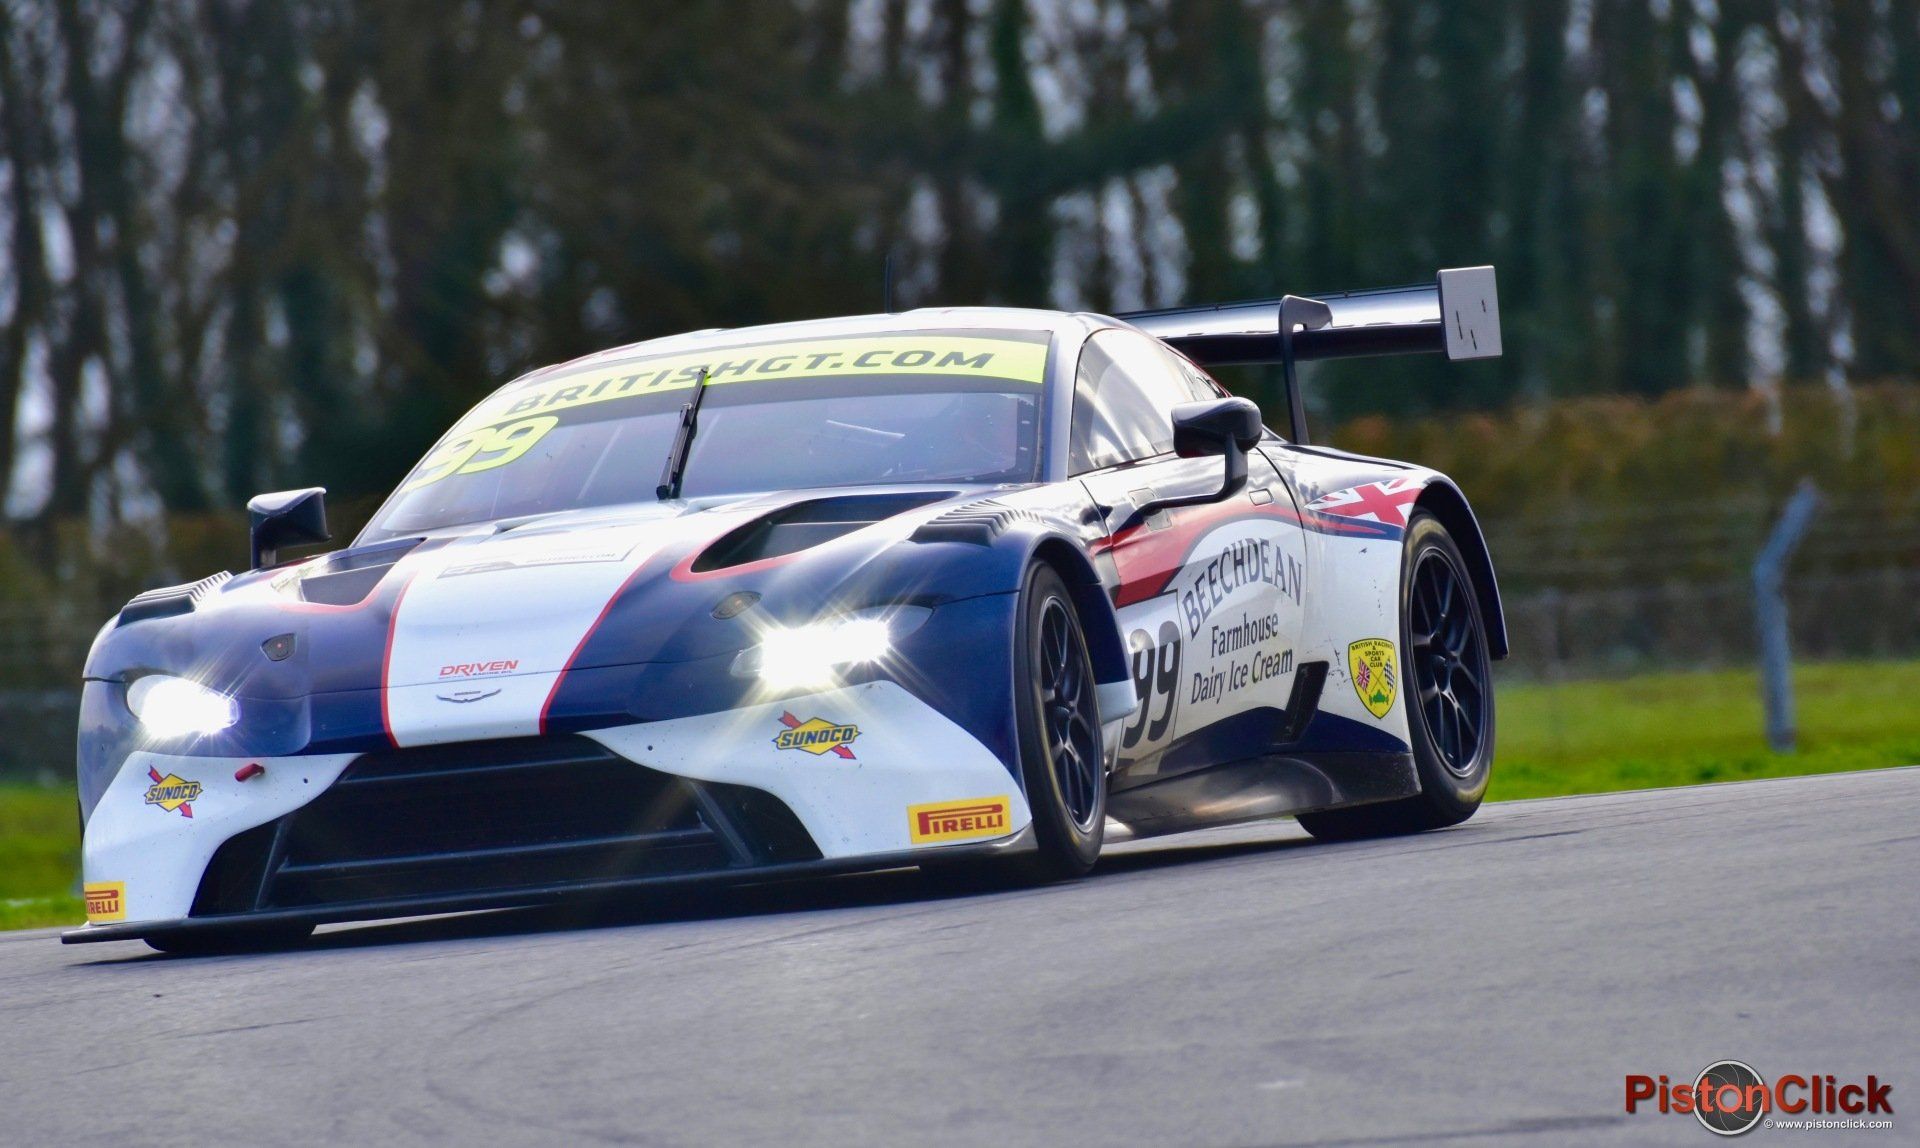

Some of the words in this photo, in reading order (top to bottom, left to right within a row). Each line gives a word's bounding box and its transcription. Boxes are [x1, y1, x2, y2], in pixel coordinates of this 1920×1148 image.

[402, 415, 558, 493] 99
[1182, 537, 1302, 641] BEECHDEAN
[1211, 611, 1279, 659] Farmhouse
[1351, 641, 1372, 650] BRITISH
[439, 660, 518, 676] DRIVEN
[1122, 620, 1181, 748] 99
[1191, 665, 1226, 705] Dairy
[1228, 660, 1248, 692] Ice
[1252, 648, 1293, 684] Cream
[780, 727, 855, 747] SUNOCO
[149, 785, 197, 800] SUNOCO
[917, 803, 1003, 836] PIRELLI
